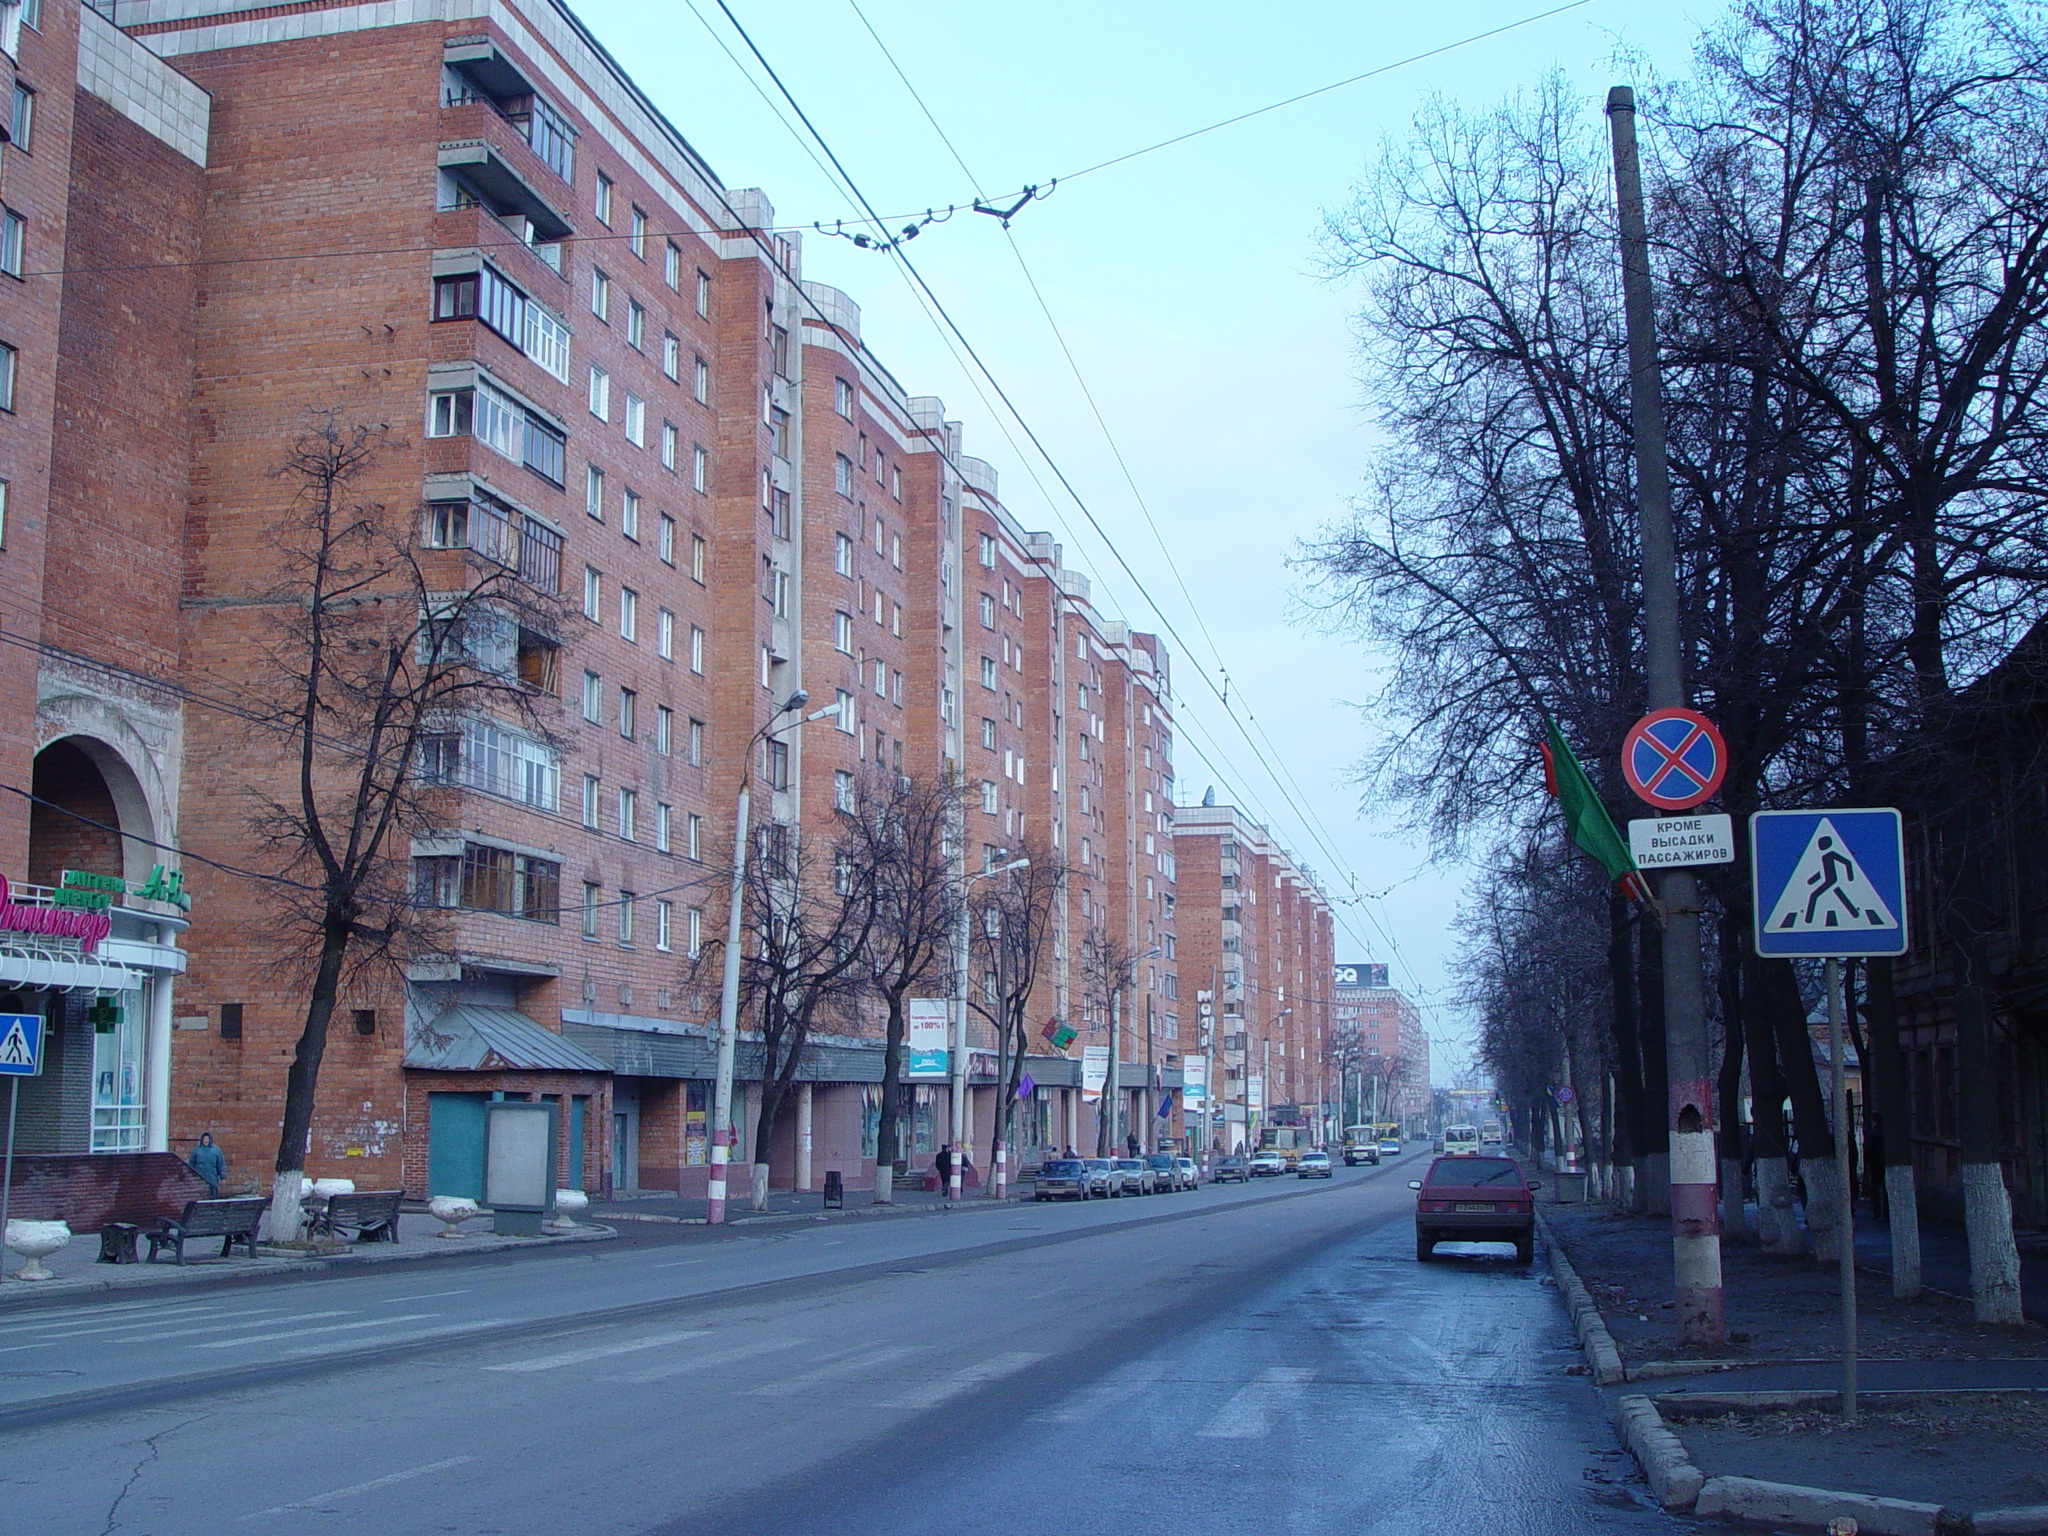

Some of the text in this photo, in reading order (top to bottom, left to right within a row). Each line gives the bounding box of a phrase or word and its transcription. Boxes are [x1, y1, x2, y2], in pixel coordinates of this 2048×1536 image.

[1657, 820, 1702, 834] КРОМЕ
[1651, 834, 1714, 849] ВЫСАДКИ
[1638, 848, 1727, 865] ПАССАЖИРОВ
[0, 873, 111, 952] питер
